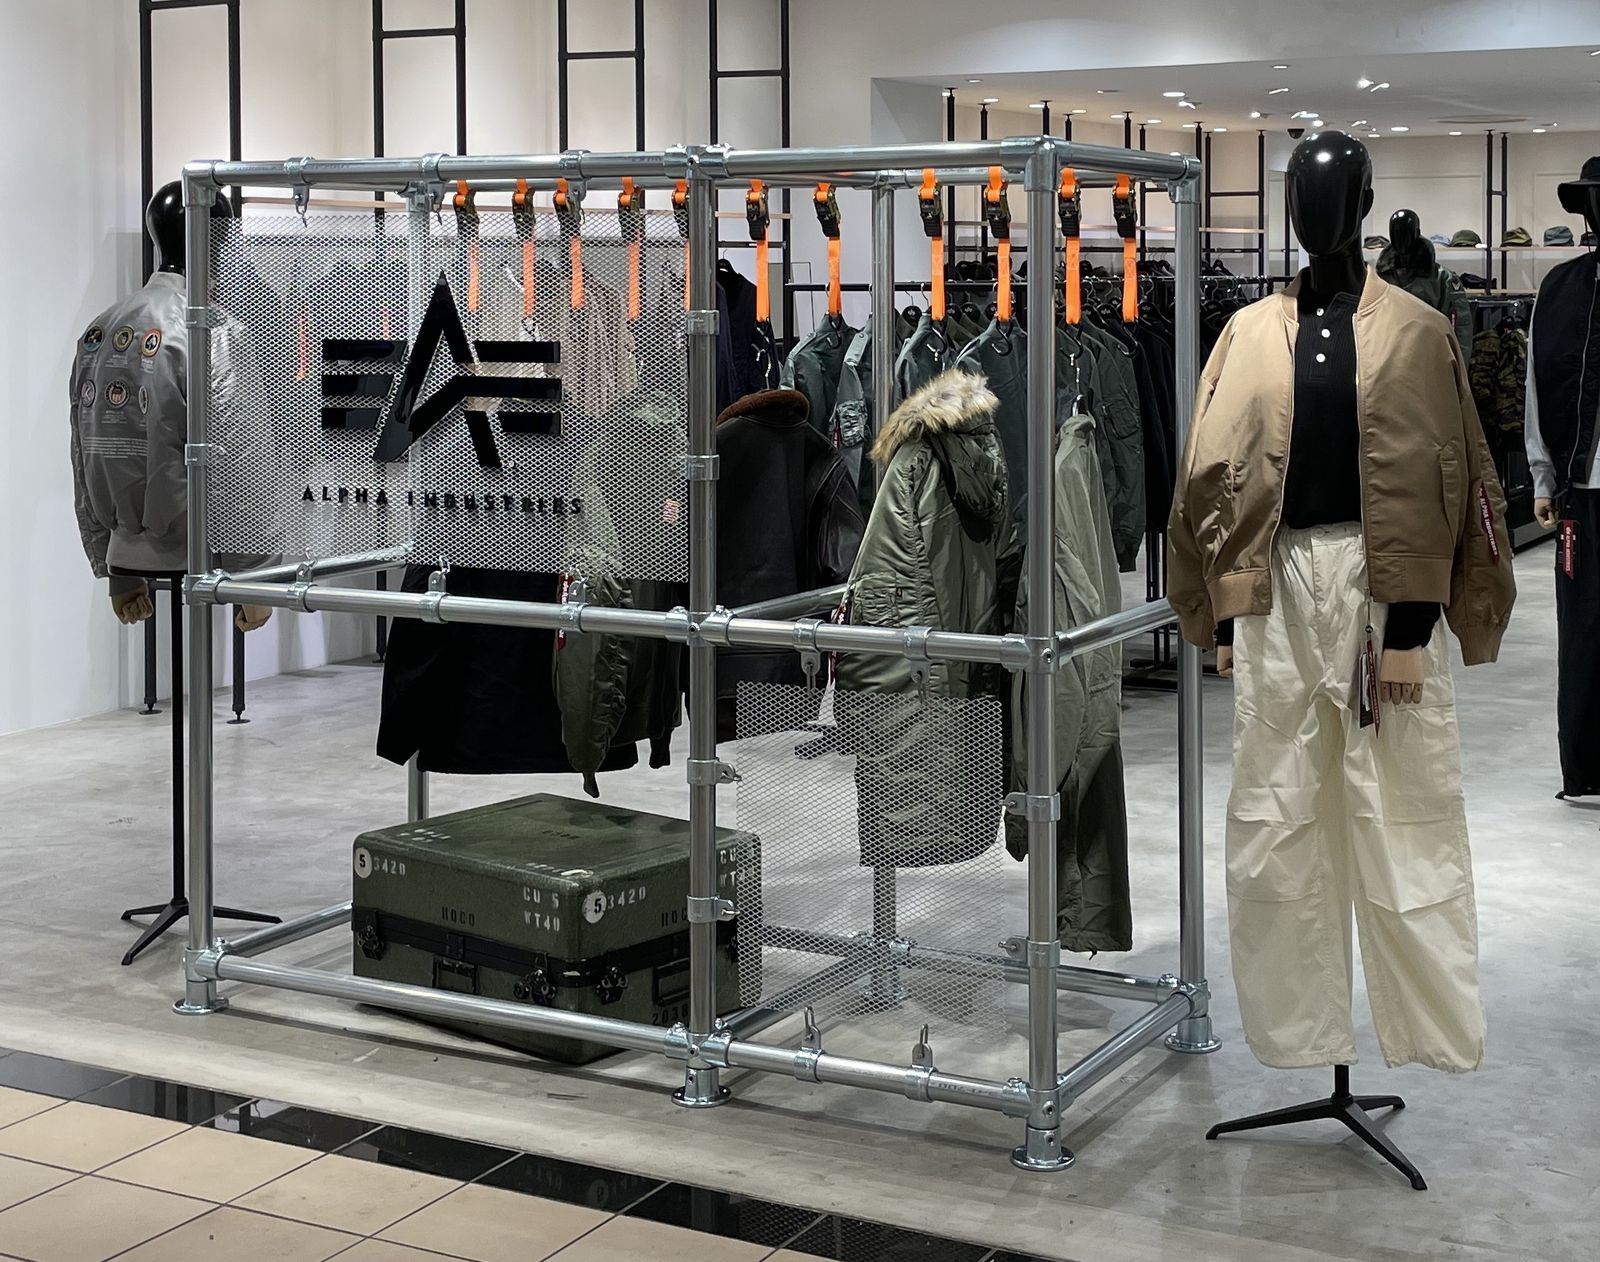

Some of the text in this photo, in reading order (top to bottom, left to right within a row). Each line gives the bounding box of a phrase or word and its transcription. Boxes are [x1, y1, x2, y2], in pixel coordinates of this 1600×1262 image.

[301, 484, 583, 516] ALPHA INDUSTRIES
[523, 886, 541, 903] CU
